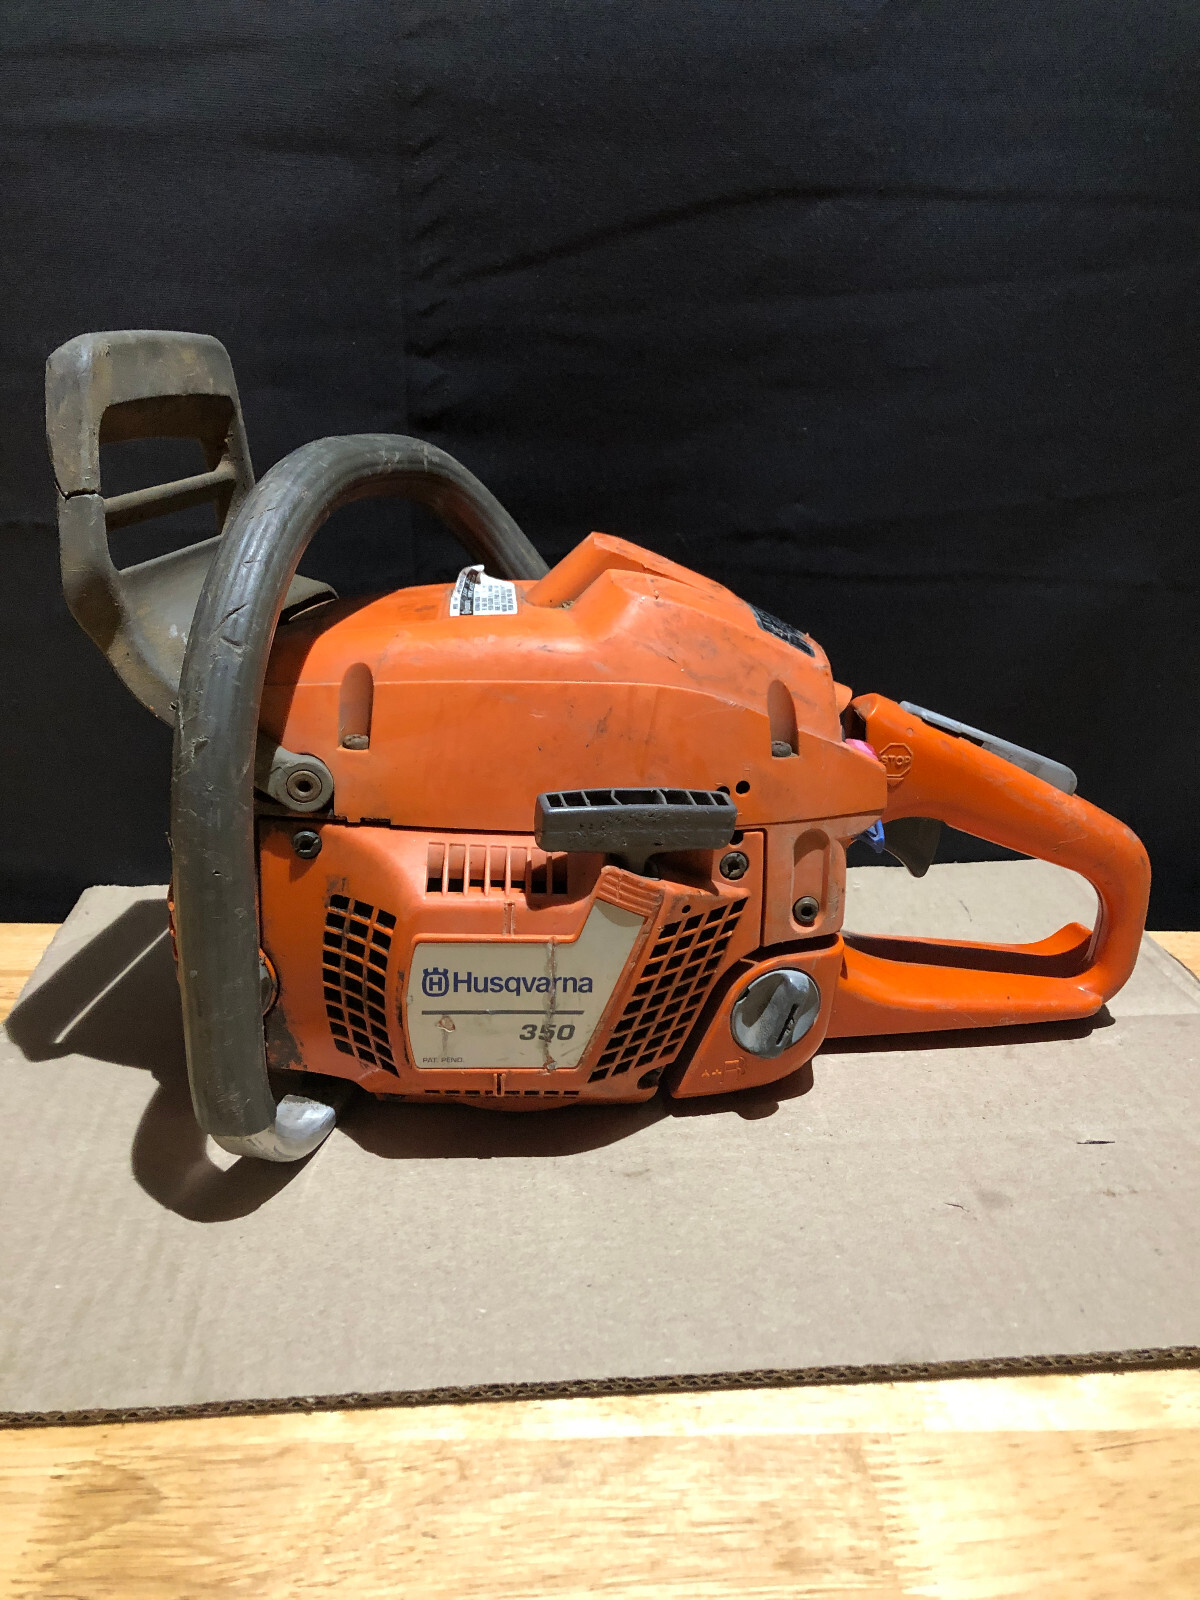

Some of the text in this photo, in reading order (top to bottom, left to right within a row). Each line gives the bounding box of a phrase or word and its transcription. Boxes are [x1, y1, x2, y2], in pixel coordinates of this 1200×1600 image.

[880, 754, 911, 767] STOP
[453, 971, 593, 996] Husqvarna
[519, 1024, 576, 1041] 350
